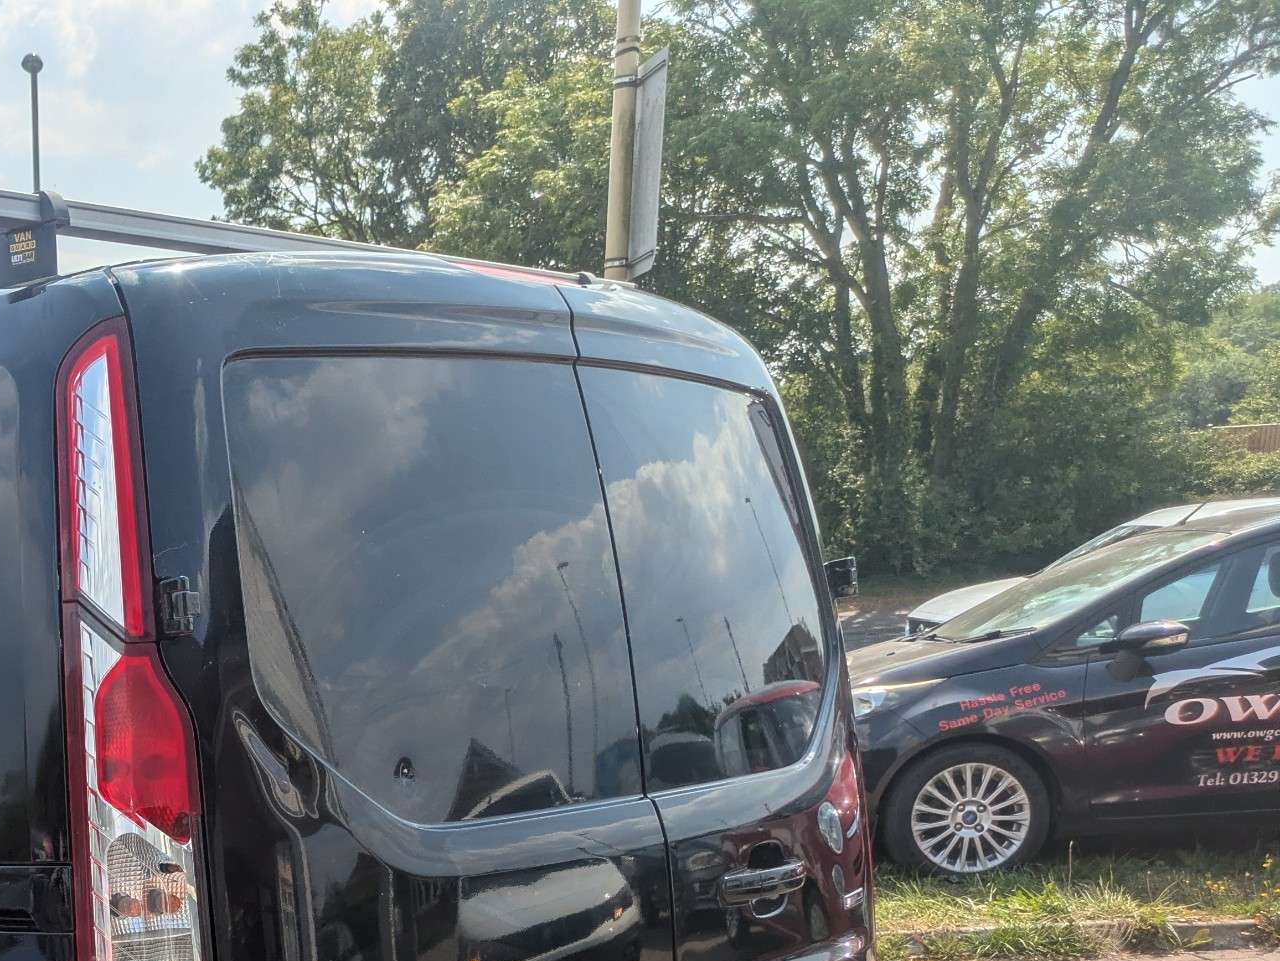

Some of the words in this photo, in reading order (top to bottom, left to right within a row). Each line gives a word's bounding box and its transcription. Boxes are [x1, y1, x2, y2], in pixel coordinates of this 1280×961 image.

[14, 230, 32, 242] VAN
[960, 693, 1006, 712] Hassle
[1009, 683, 1041, 698] Free
[938, 714, 978, 731] Same
[983, 705, 1008, 720] Day
[1014, 688, 1067, 711] Service
[1215, 745, 1262, 763] WE
[1198, 772, 1225, 788] Tel:
[1229, 771, 1279, 785] 01329
